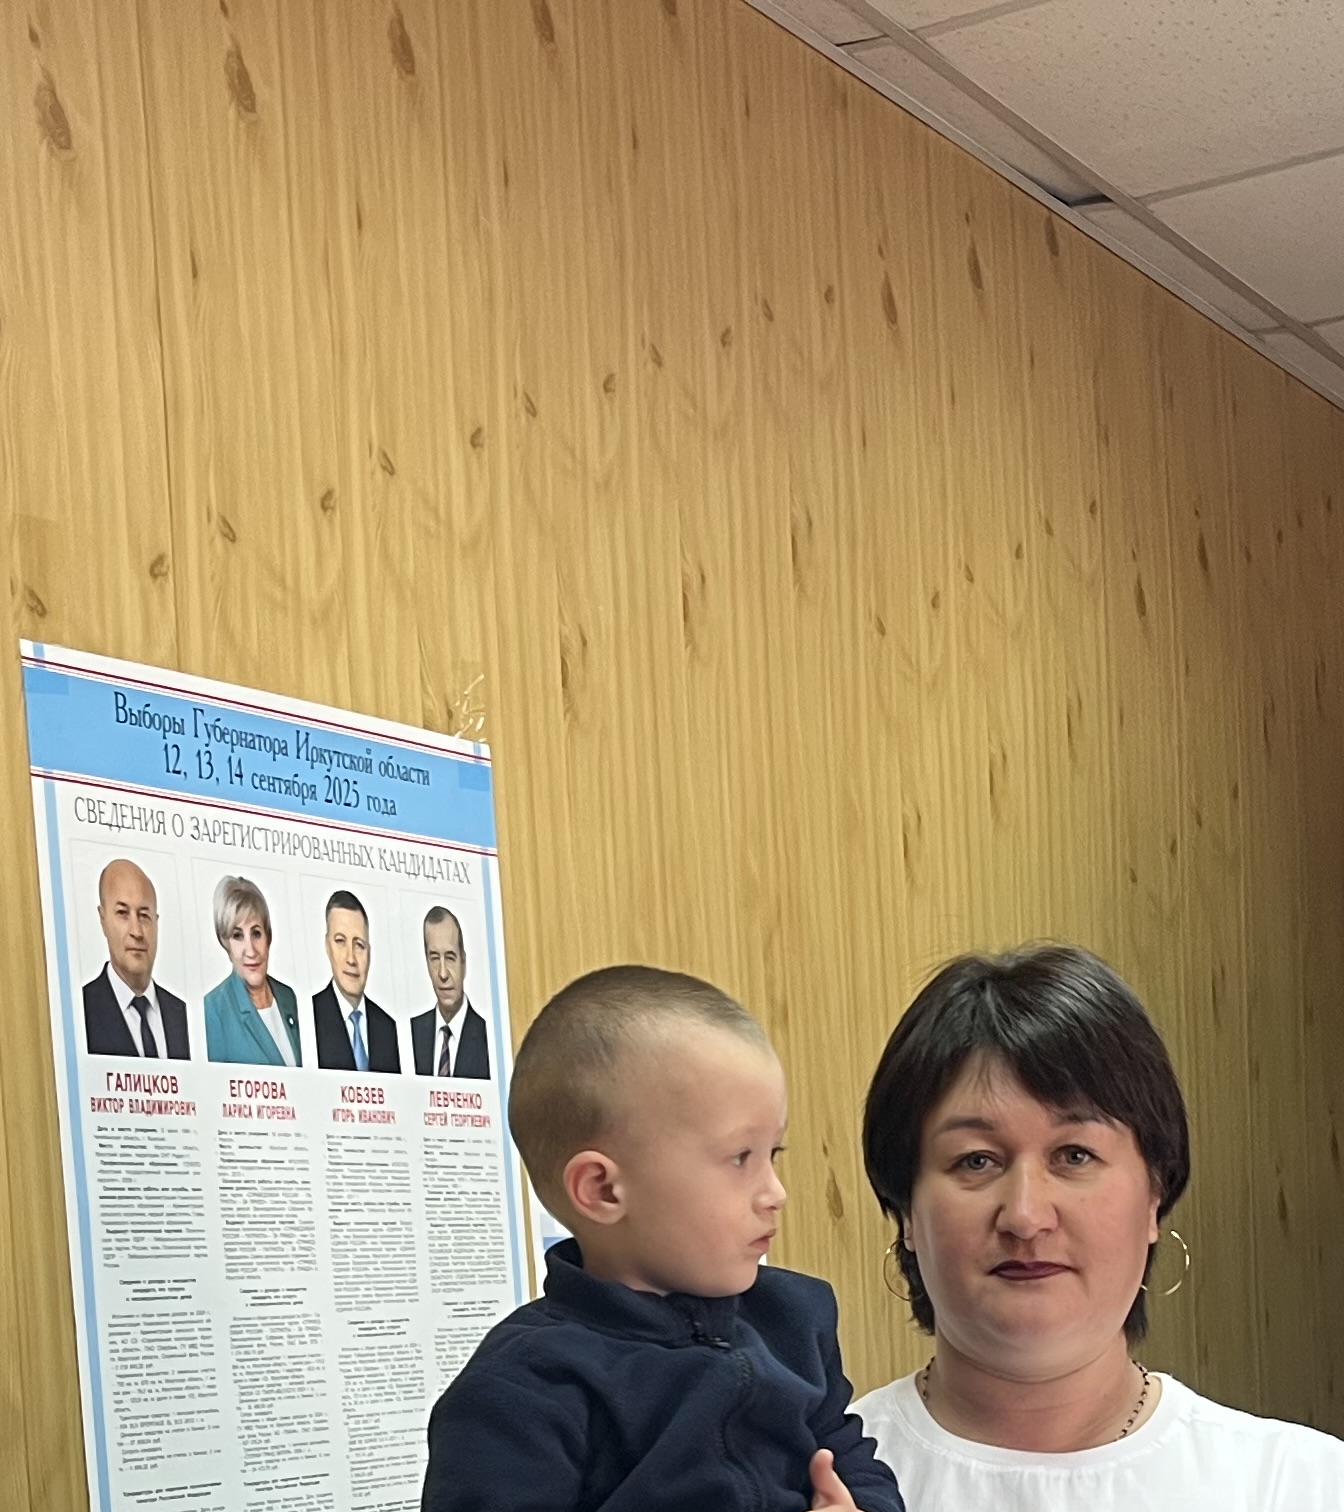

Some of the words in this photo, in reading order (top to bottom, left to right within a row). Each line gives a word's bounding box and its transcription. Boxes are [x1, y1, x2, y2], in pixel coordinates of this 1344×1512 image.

[113, 692, 186, 740] Выборы
[192, 707, 289, 761] Губернатора
[295, 729, 374, 774] Иркутской
[378, 755, 431, 786] области
[162, 743, 188, 781] 12,
[196, 749, 220, 787] 13,
[227, 755, 244, 787] 14
[251, 772, 318, 806] сентября
[324, 774, 360, 809] 2025
[366, 794, 398, 816] года
[74, 796, 167, 834] СВЕДЕНИЯ
[171, 813, 184, 838] О
[190, 816, 375, 869] ЗАРЕГИСТРИРОВАННЫХ
[377, 847, 471, 884] КАНДИДАТАХ
[106, 1072, 179, 1096] ГАЛИЦКОВ
[229, 1079, 287, 1100] ЕГОРОВА
[340, 1085, 385, 1105] КОБЗЕВ
[429, 1090, 483, 1109] ЛЕВЧЕНКО
[90, 1097, 124, 1114] ВИКТОР
[129, 1098, 197, 1117] ВЛАДИМИРОВИЧ
[257, 1105, 296, 1121] ИГОРЕВНА
[332, 1108, 355, 1123] ИГОРЬ
[423, 1111, 448, 1127] СЕРГЕЙ
